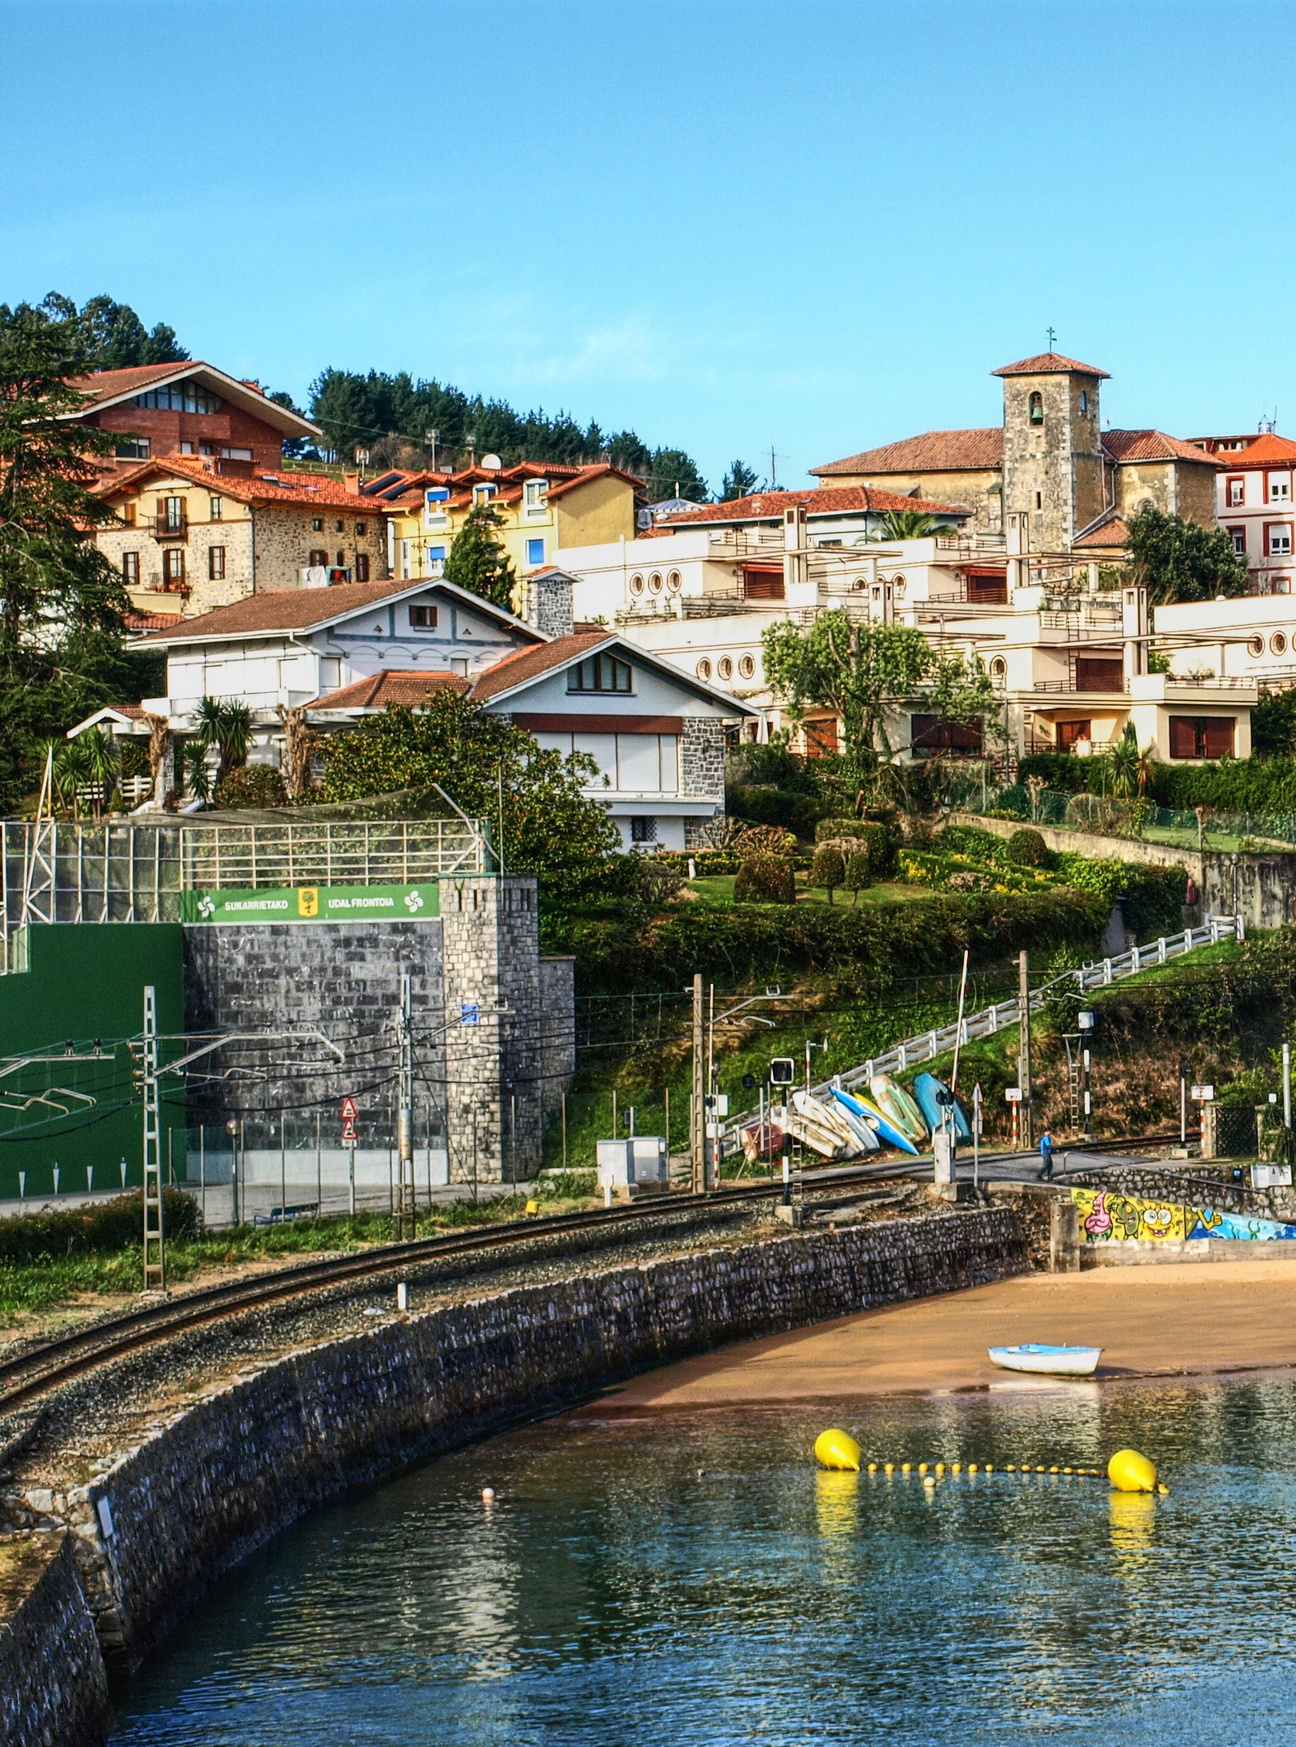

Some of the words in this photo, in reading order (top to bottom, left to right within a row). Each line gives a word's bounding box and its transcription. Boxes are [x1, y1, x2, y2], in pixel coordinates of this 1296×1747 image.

[225, 900, 288, 911] SUKARRIETAKO
[328, 899, 351, 908] UDAL
[351, 897, 394, 908] FRONTOIA
